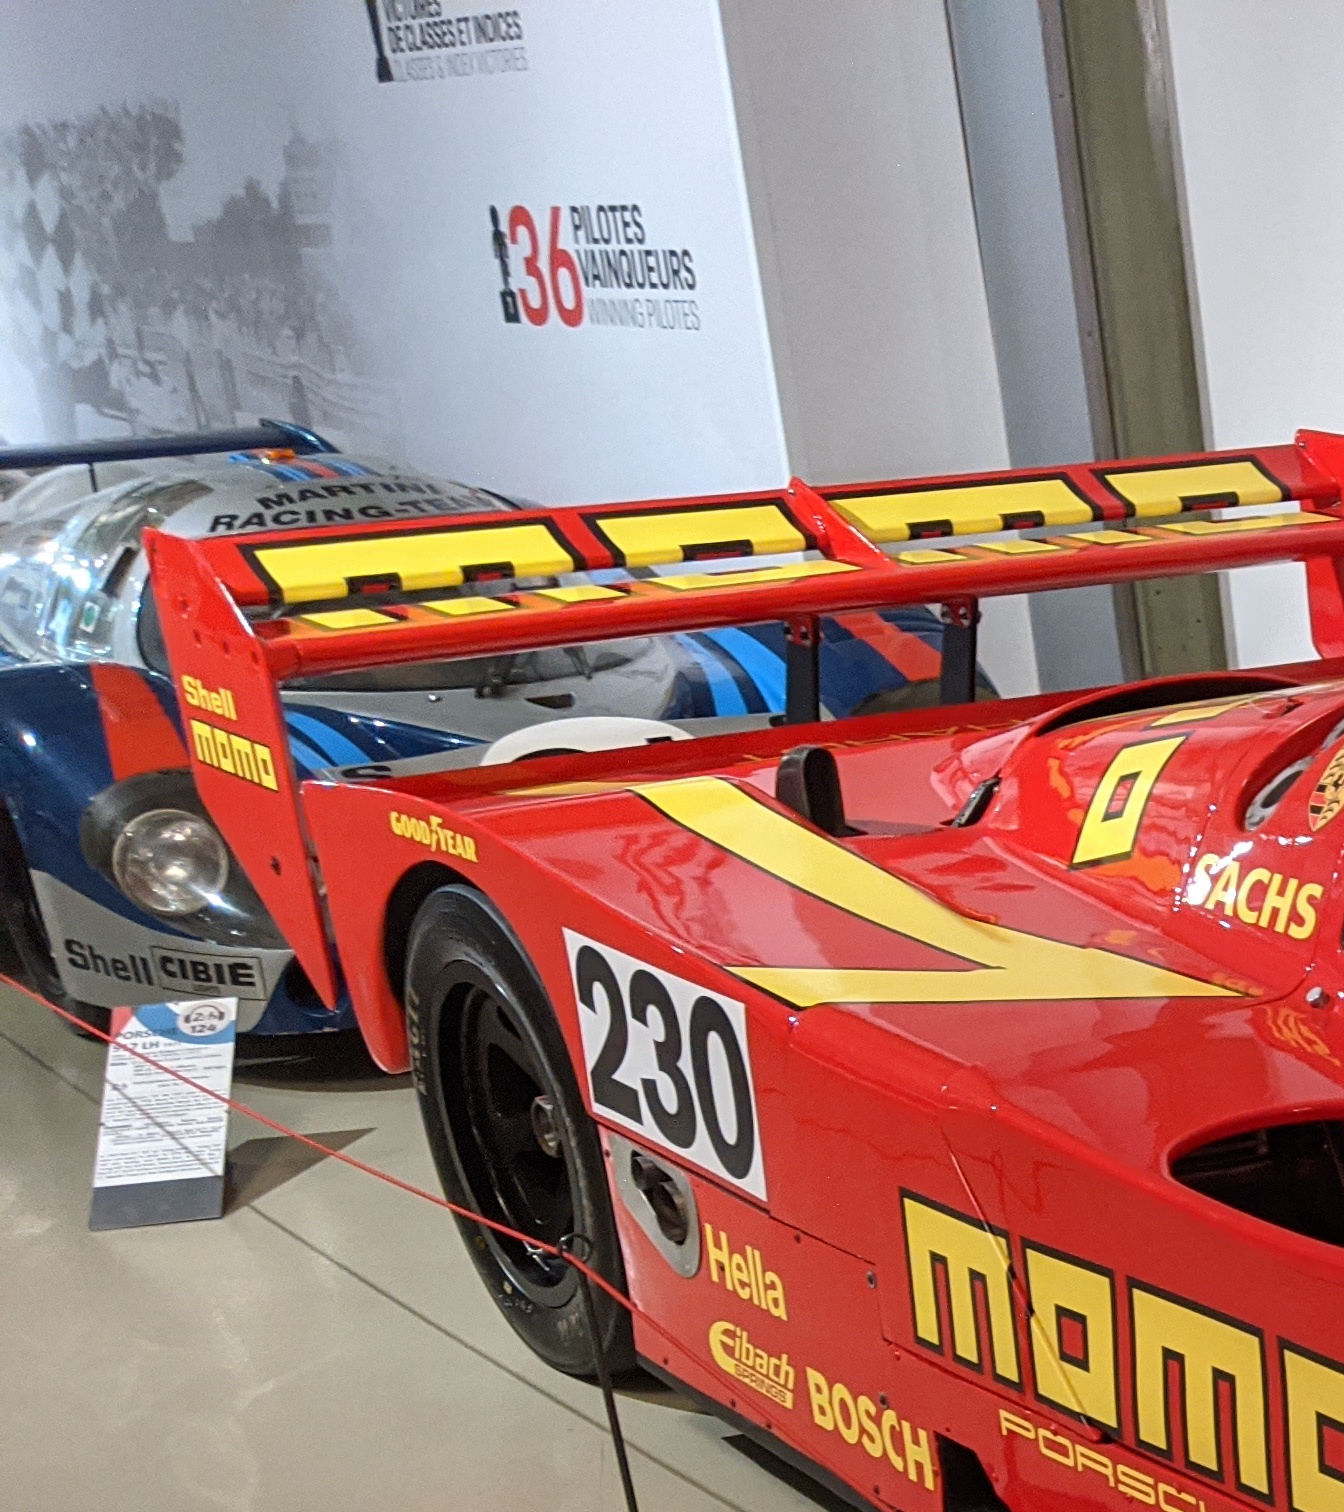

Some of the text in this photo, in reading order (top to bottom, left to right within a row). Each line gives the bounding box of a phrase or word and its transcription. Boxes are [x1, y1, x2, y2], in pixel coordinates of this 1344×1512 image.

[456, 17, 472, 46] ET
[569, 204, 646, 245] PILOTES
[508, 205, 584, 328] 36
[575, 249, 697, 290] VAINQUEURS
[256, 482, 441, 510] MARTINI
[182, 674, 237, 721] Shell
[390, 811, 478, 862] GOODYEAR
[1187, 853, 1323, 940] SACHS
[64, 938, 155, 987] Shell
[576, 944, 756, 1180] 230
[704, 1223, 788, 1321] Hella
[709, 1320, 795, 1392] Eibach
[806, 1366, 935, 1490] BOSCH
